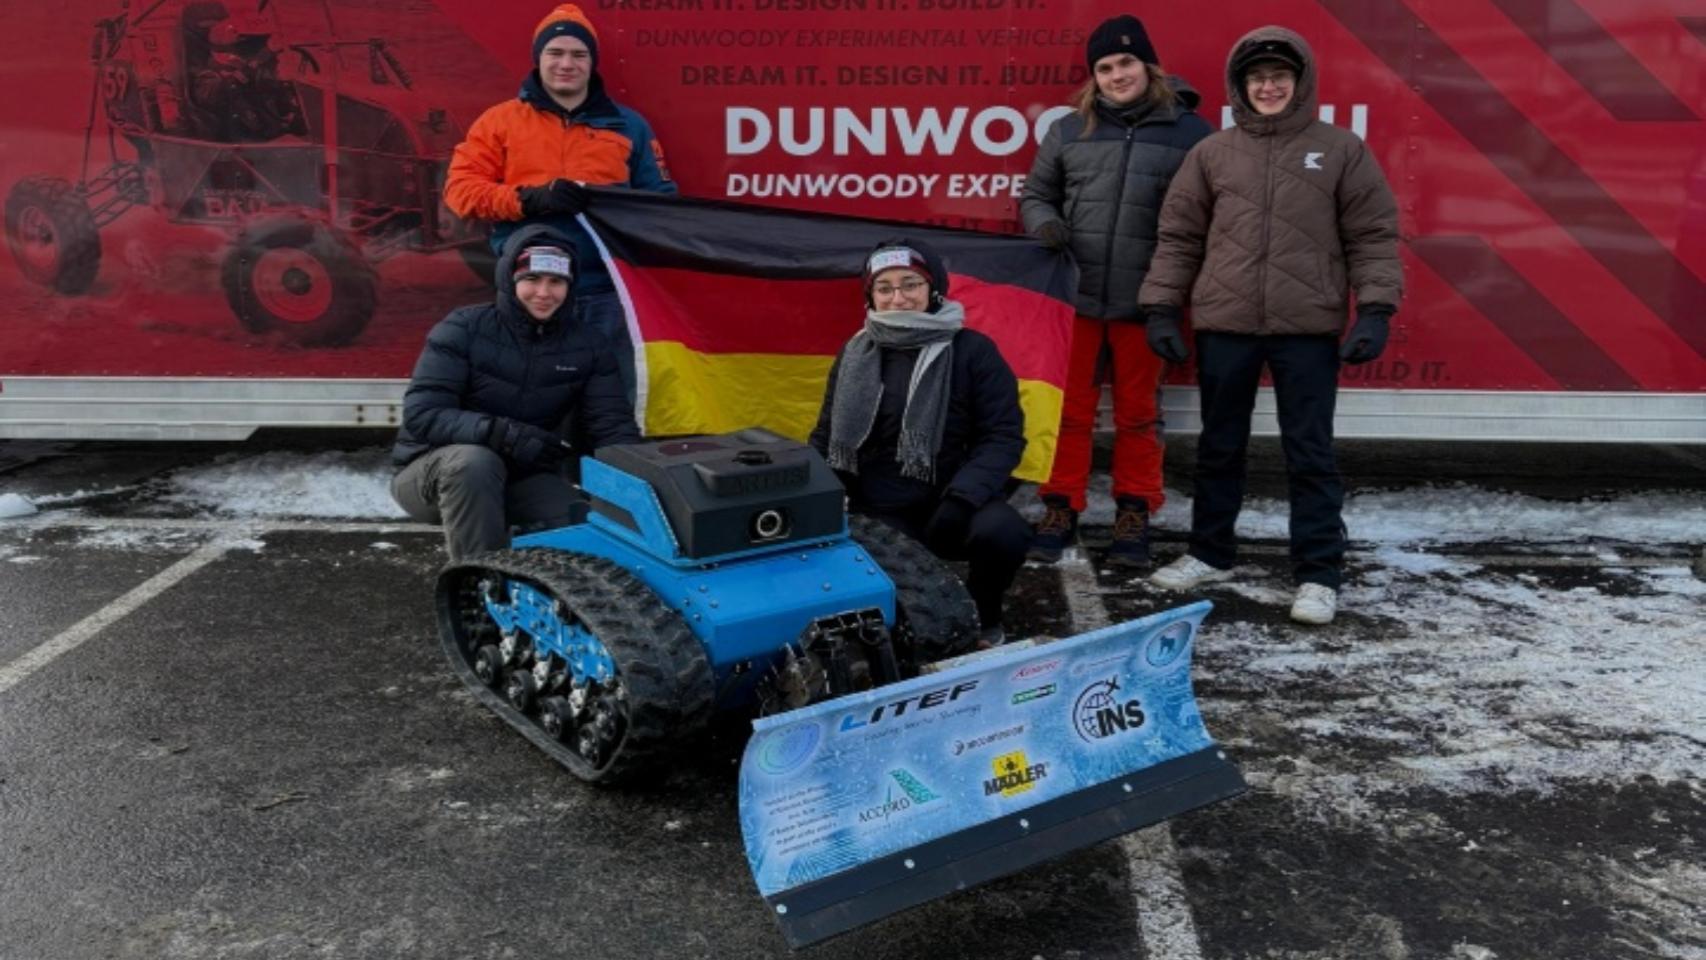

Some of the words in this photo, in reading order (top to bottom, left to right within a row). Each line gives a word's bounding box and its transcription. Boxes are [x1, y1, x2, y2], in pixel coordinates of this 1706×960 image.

[635, 29, 789, 48] DUNWOODY
[795, 28, 966, 48] EXPERIMENTAL
[975, 28, 1087, 47] VEHICLES
[681, 65, 786, 86] DREAM
[796, 65, 827, 86] IT.
[837, 64, 949, 86] DESIGN
[959, 64, 992, 86] IT.
[999, 64, 1087, 86] BUILD
[726, 173, 940, 198] DUNWOODY
[1342, 360, 1409, 383] UILD
[1420, 360, 1451, 383] IT.
[839, 680, 980, 733] LITEF
[1095, 699, 1146, 738] INS
